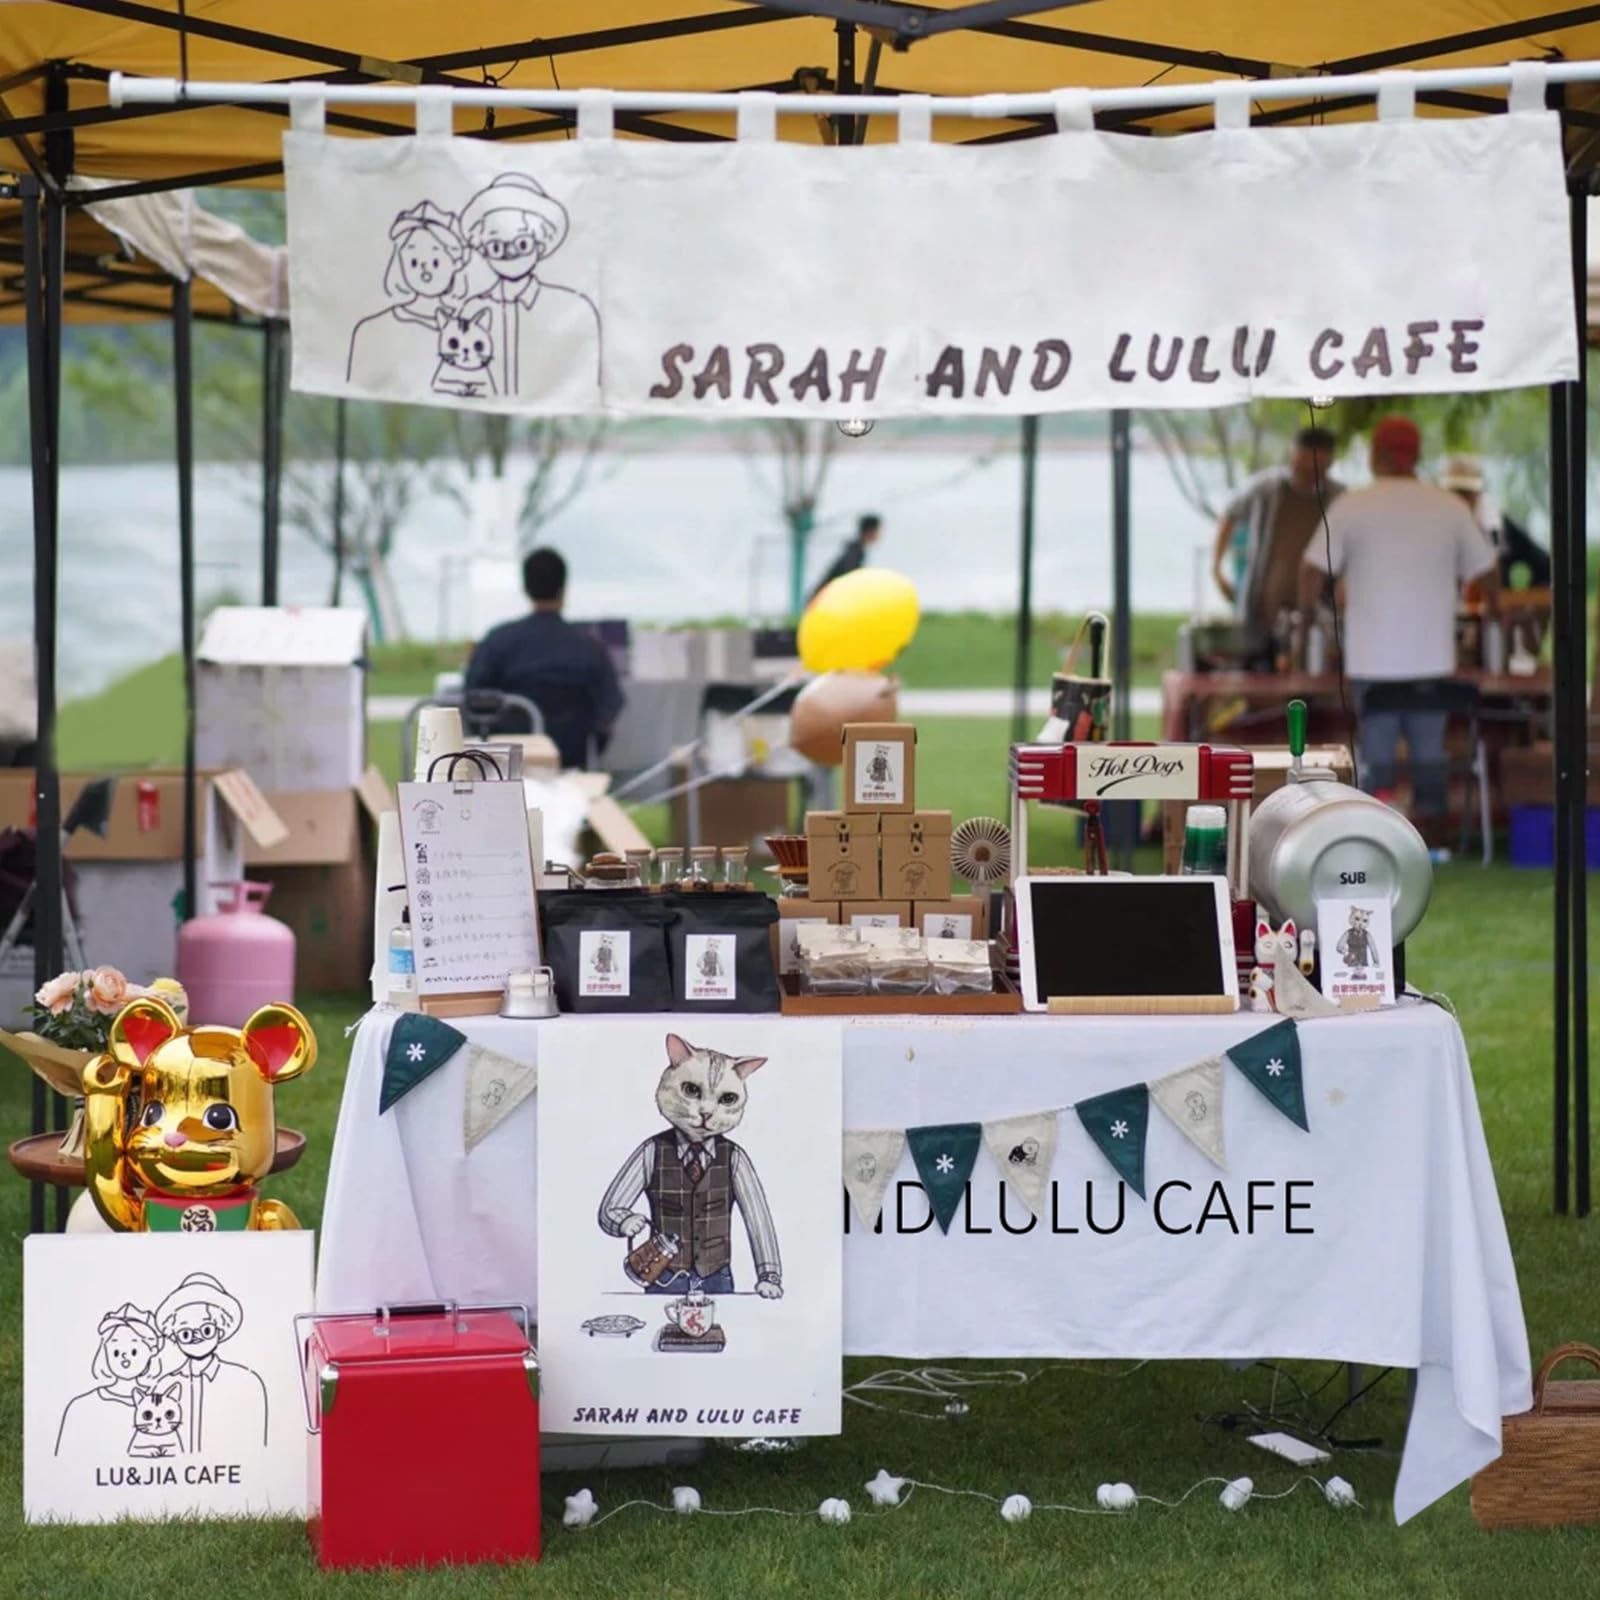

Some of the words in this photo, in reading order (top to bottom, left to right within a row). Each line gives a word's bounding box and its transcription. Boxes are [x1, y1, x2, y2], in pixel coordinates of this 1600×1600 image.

[649, 343, 887, 405] SARAH
[925, 338, 1072, 398] AND
[1108, 325, 1276, 383] LULU
[1309, 320, 1485, 380] CAFE
[1088, 756, 1129, 778] Hot
[1132, 754, 1184, 777] Dogs
[1340, 871, 1366, 885] SUB
[965, 1180, 1125, 1235] LULU
[1153, 1180, 1315, 1235] CAFE
[573, 1407, 639, 1424] SARAH
[646, 1408, 688, 1424] AND
[696, 1408, 744, 1424] LULU
[752, 1408, 802, 1424] CAFE
[96, 1466, 178, 1487] LU&JIA
[184, 1465, 241, 1485] CAFE
